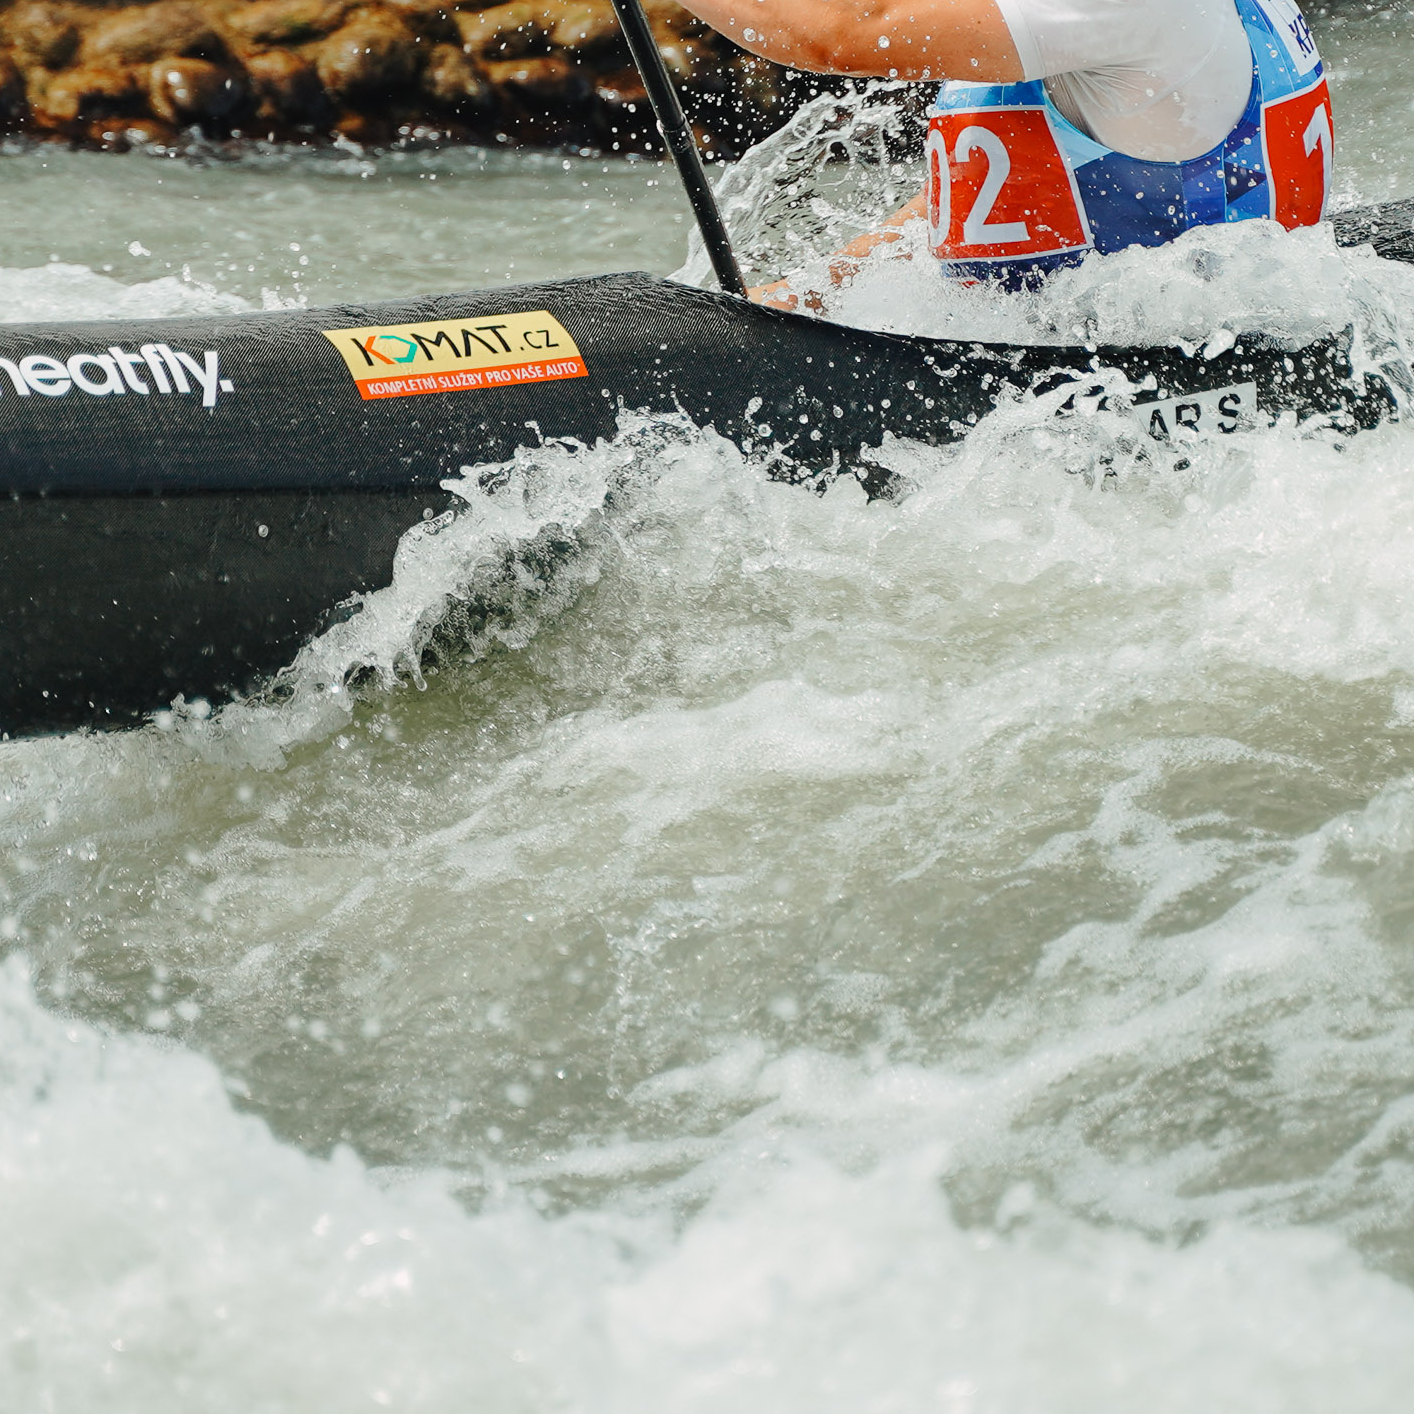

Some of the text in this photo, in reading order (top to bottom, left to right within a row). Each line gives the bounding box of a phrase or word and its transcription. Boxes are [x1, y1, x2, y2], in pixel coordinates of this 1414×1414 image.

[367, 362, 578, 395] KOMPLETNÍ SLUŽBY PRO VAŠE AUTO
